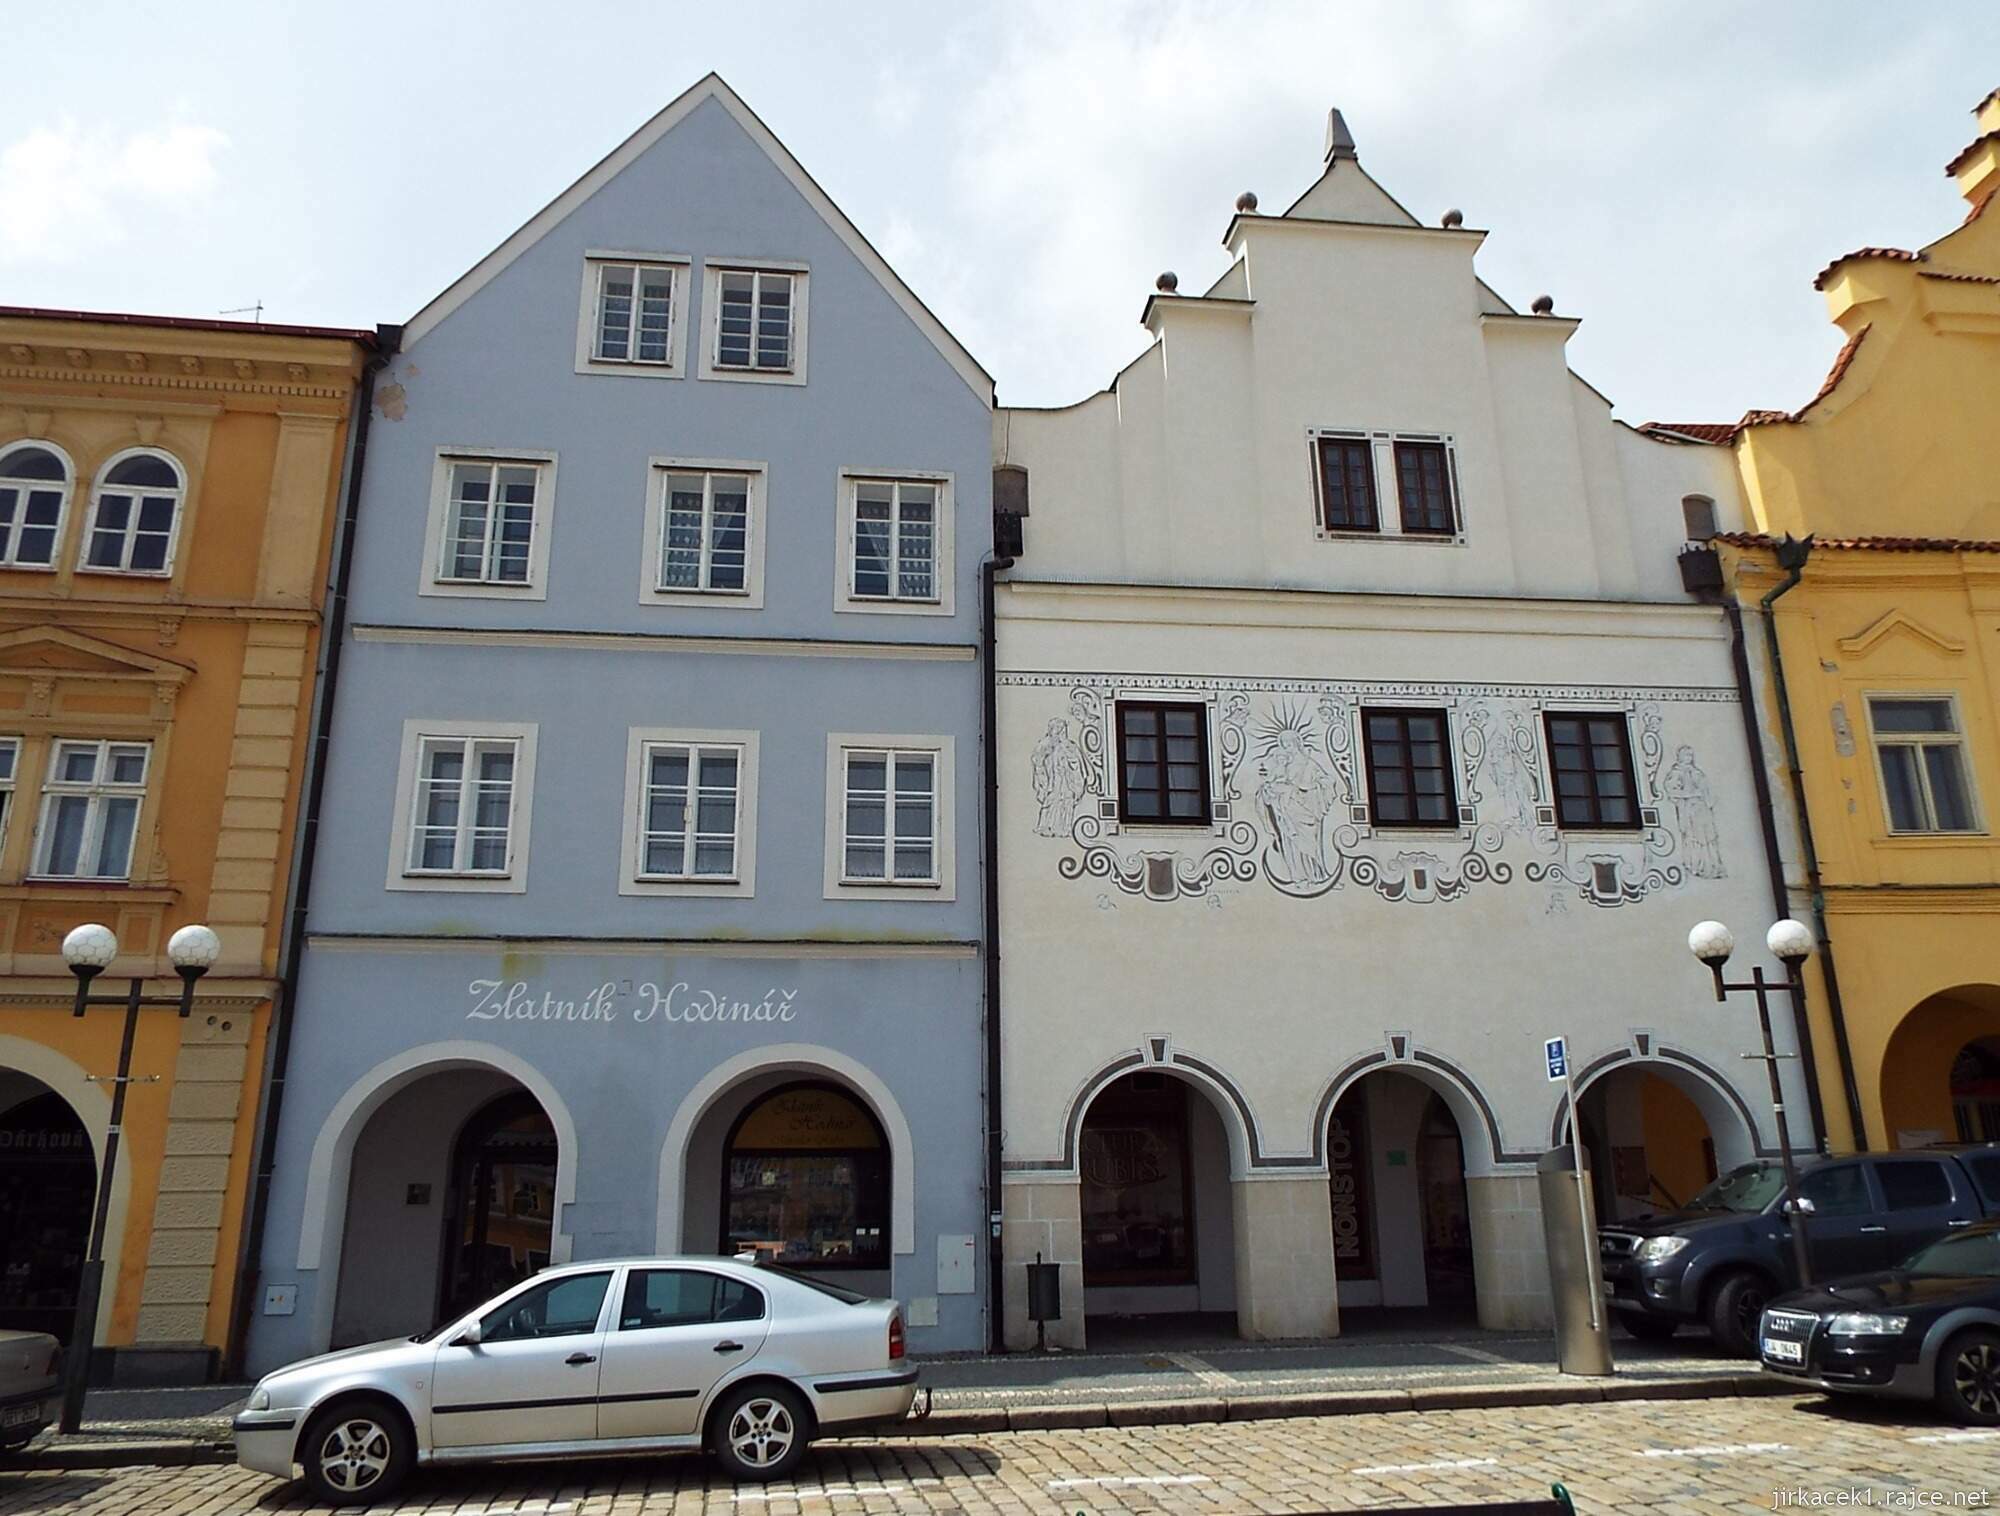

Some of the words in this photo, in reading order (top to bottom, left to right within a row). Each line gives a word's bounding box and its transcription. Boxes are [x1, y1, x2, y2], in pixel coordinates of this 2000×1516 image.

[466, 979, 617, 1023] Zlatník
[633, 982, 798, 1023] Hodinář
[1329, 1119, 1360, 1258] NONSTOP
